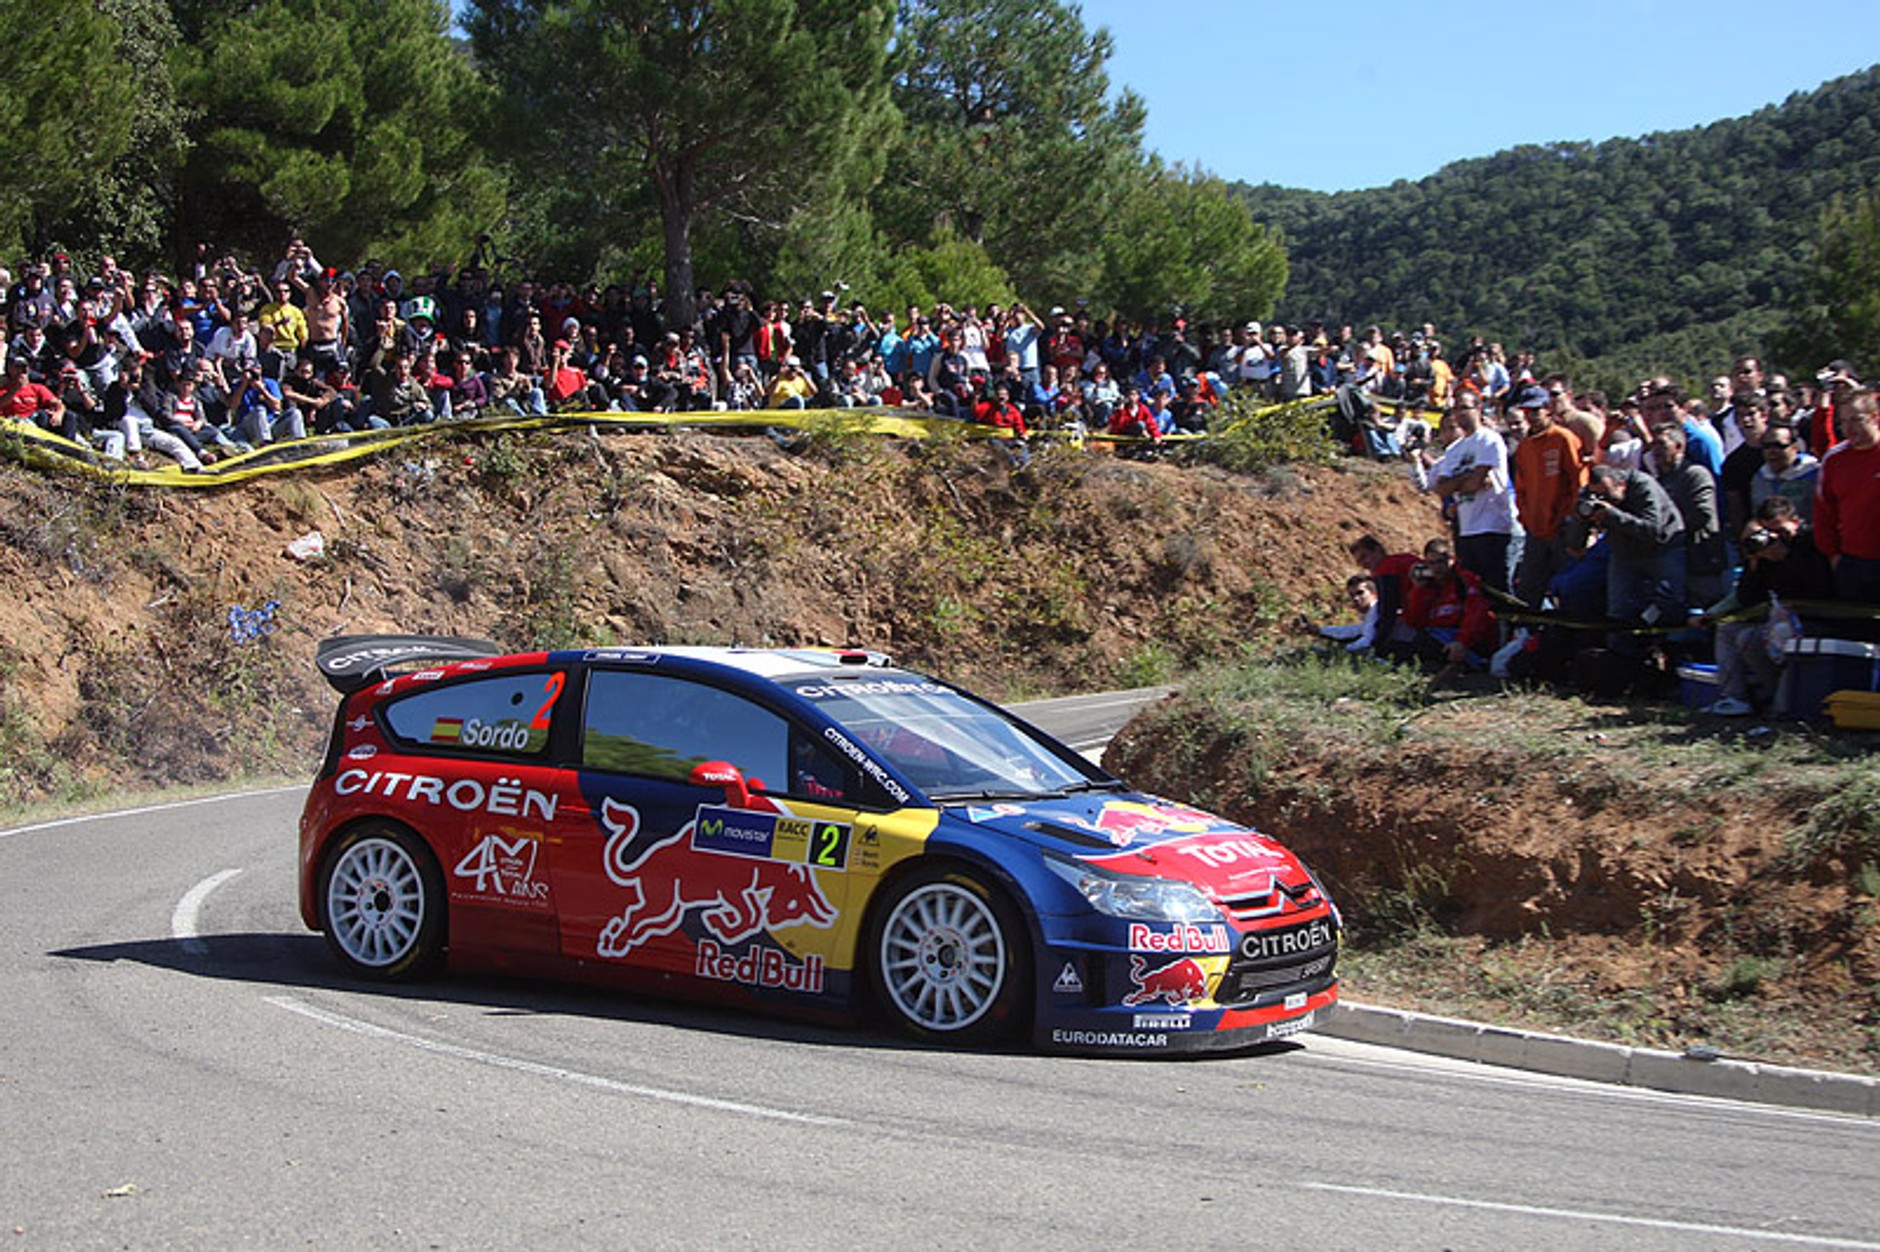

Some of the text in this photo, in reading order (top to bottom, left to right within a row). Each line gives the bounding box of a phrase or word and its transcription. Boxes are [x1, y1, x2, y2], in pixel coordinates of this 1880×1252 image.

[531, 671, 566, 730] 2
[463, 718, 529, 749] Sordo
[703, 772, 737, 781] TOTAL
[335, 769, 558, 821] CITROËN
[724, 827, 770, 842] movistar
[778, 820, 811, 838] RACC
[817, 825, 840, 866] 2
[1178, 839, 1285, 868] TOTAL
[1128, 923, 1230, 952] Red Bull
[1241, 921, 1331, 958] CITROËN
[696, 939, 823, 992] Red Bull
[1053, 1029, 1167, 1047] EURODATACAR
